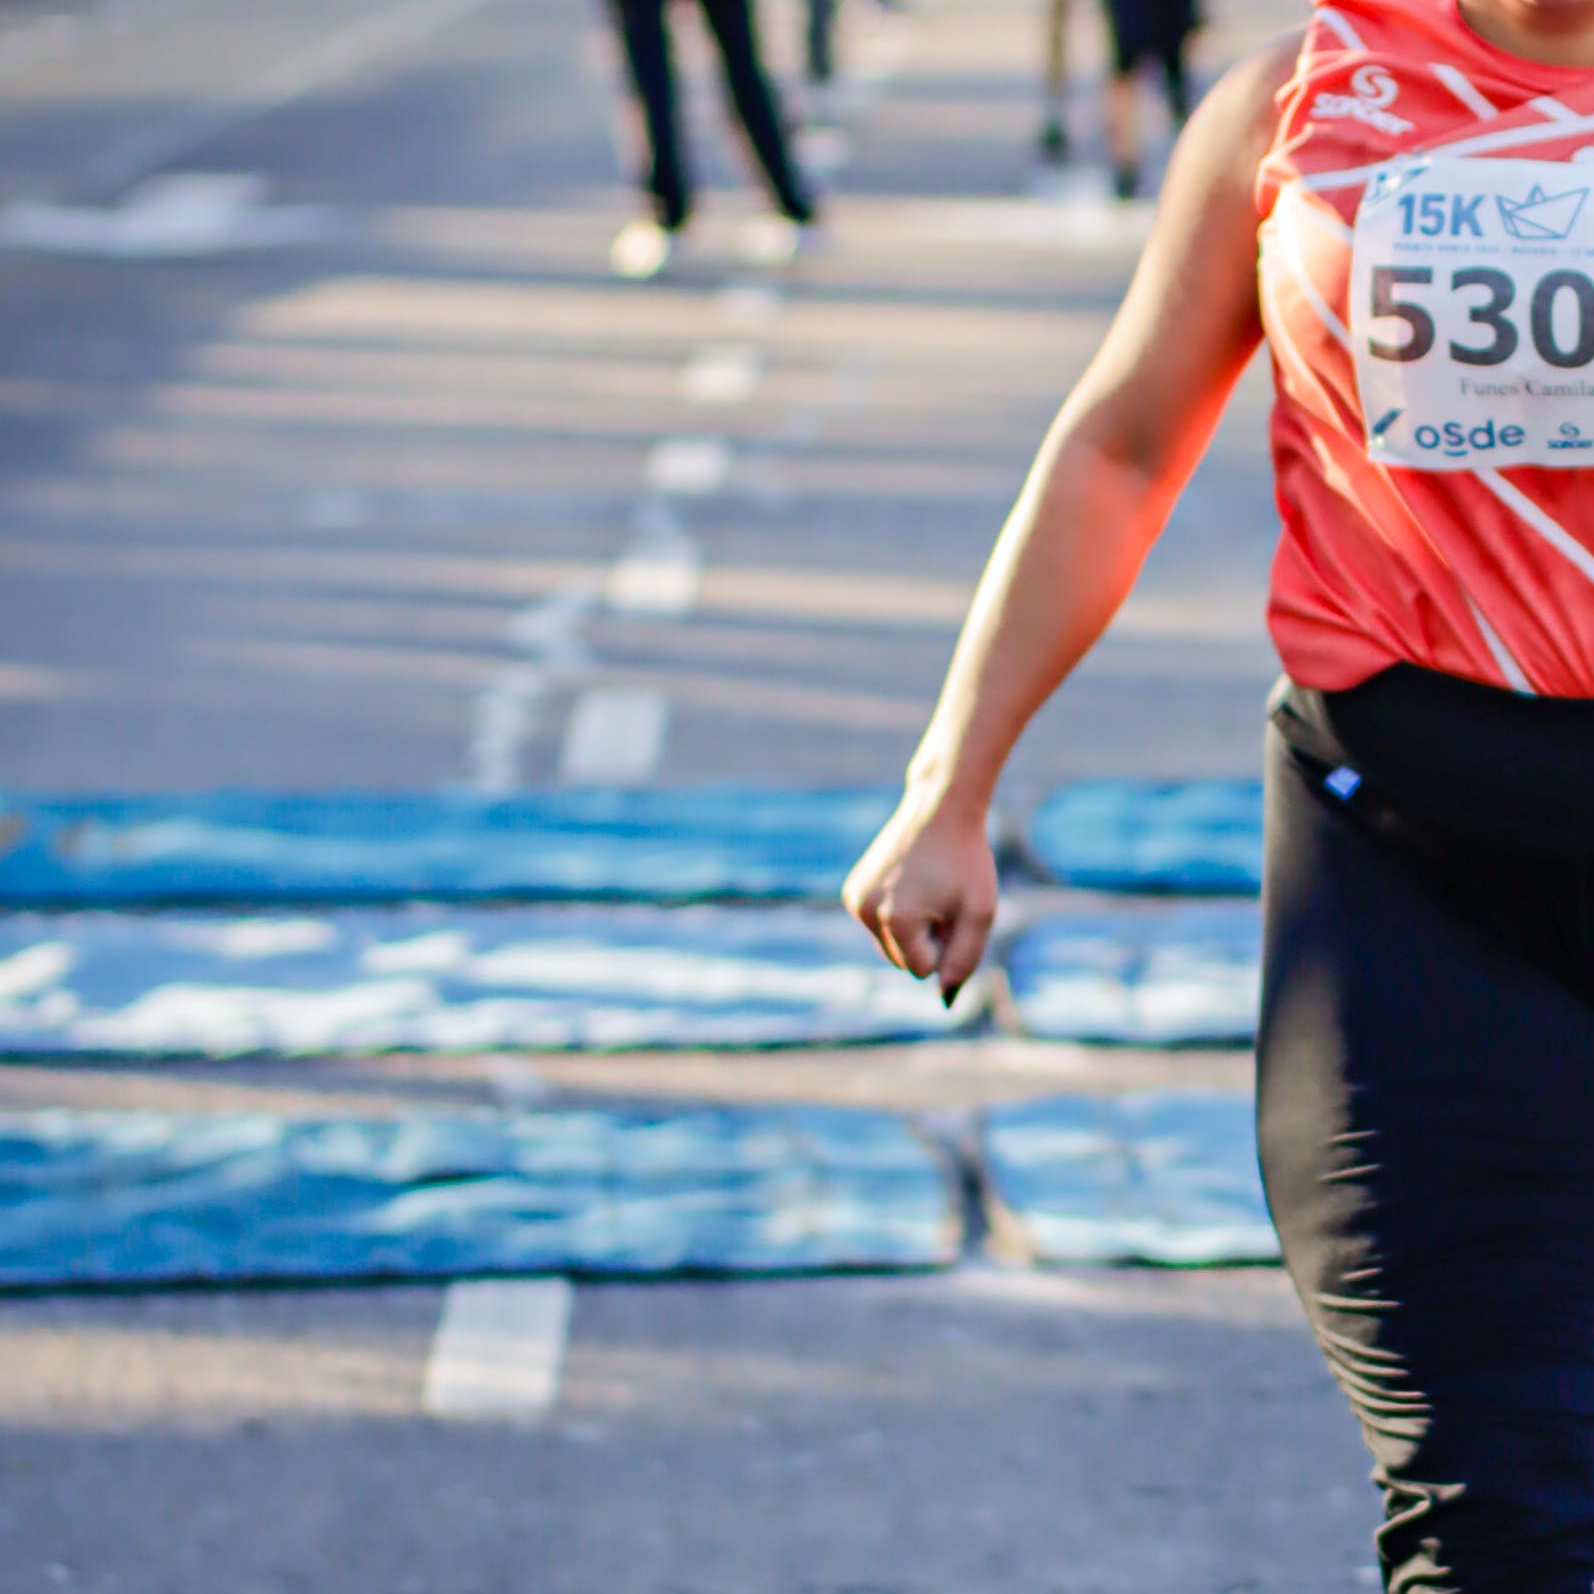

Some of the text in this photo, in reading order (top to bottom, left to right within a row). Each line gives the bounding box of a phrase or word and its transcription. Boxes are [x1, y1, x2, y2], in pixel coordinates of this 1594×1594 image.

[1398, 193, 1485, 237] 15K
[1459, 378, 1521, 397] Funes
[1414, 418, 1525, 452] osde
